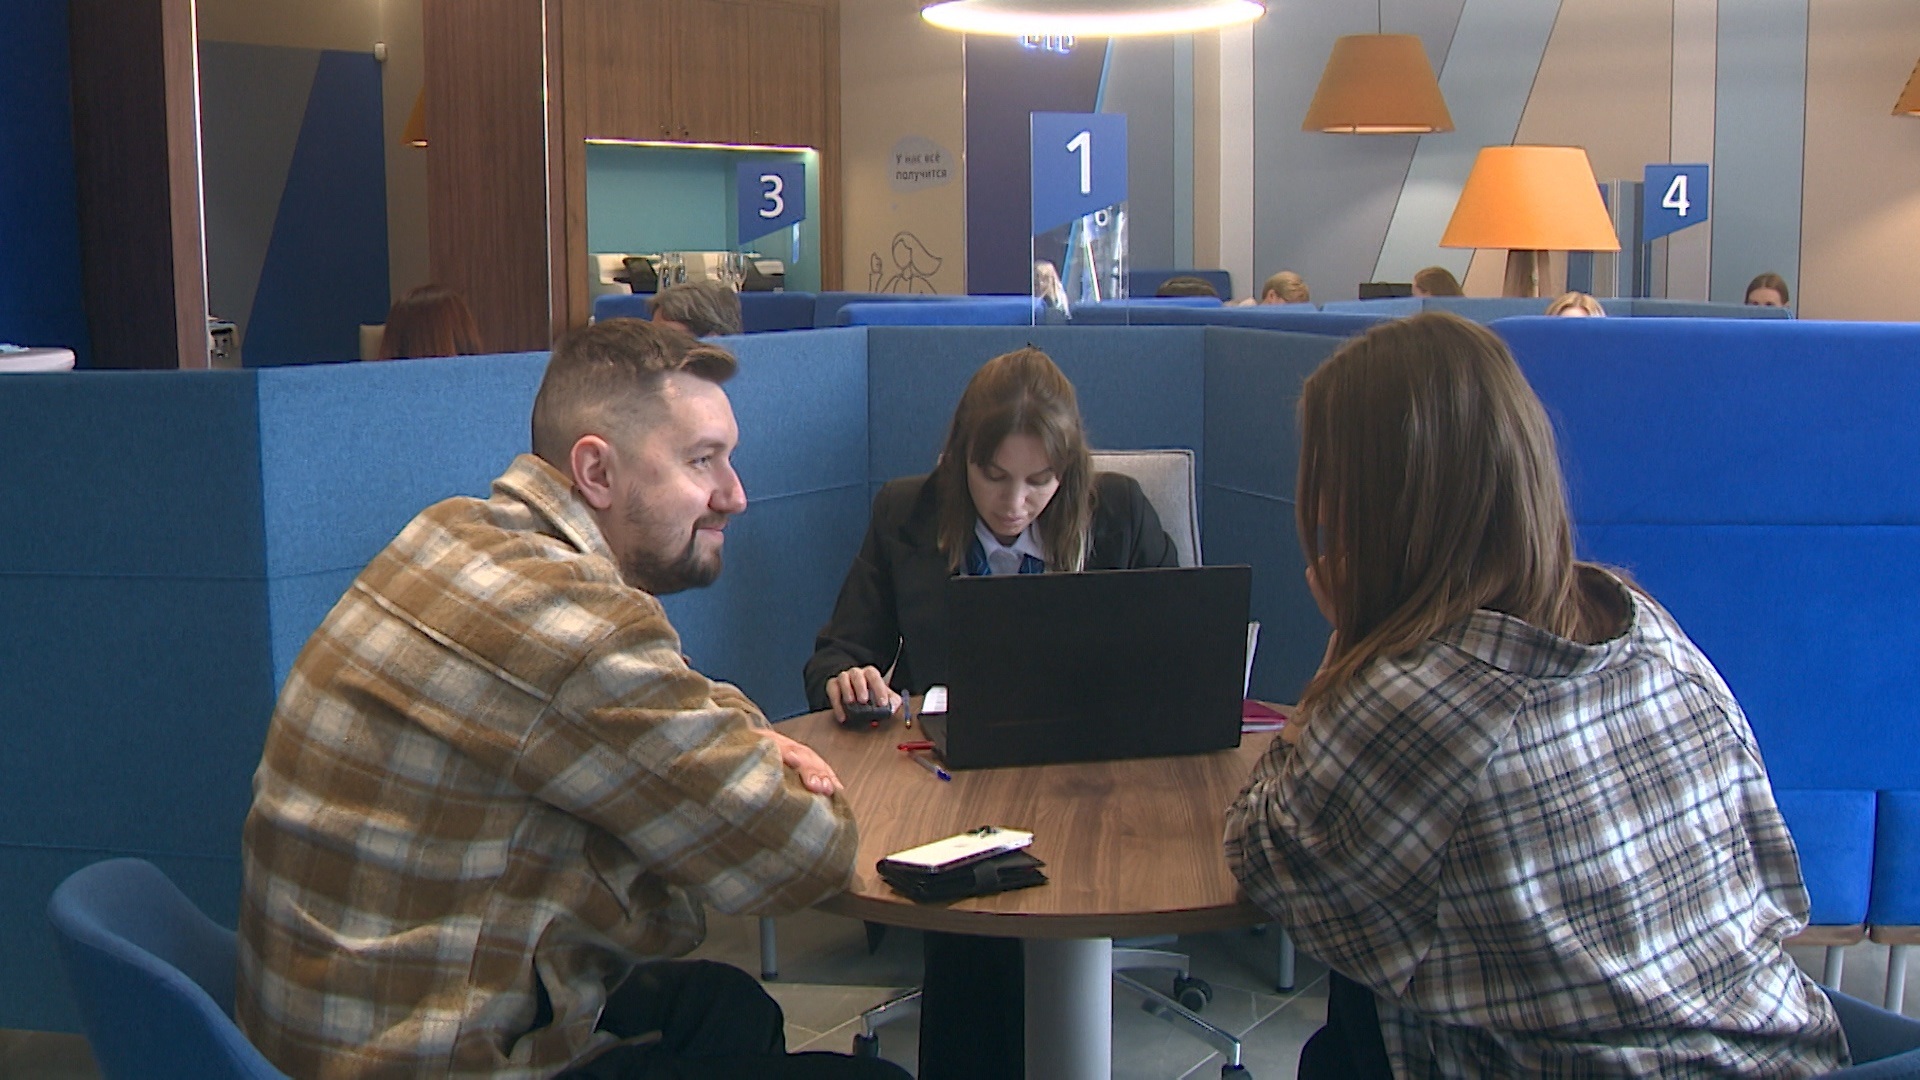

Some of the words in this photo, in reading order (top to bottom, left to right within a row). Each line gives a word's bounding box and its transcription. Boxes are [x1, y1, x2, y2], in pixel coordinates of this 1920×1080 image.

[896, 169, 947, 181] получится
[1066, 131, 1091, 194] 1
[759, 174, 784, 219] 3
[1662, 174, 1691, 217] 4
